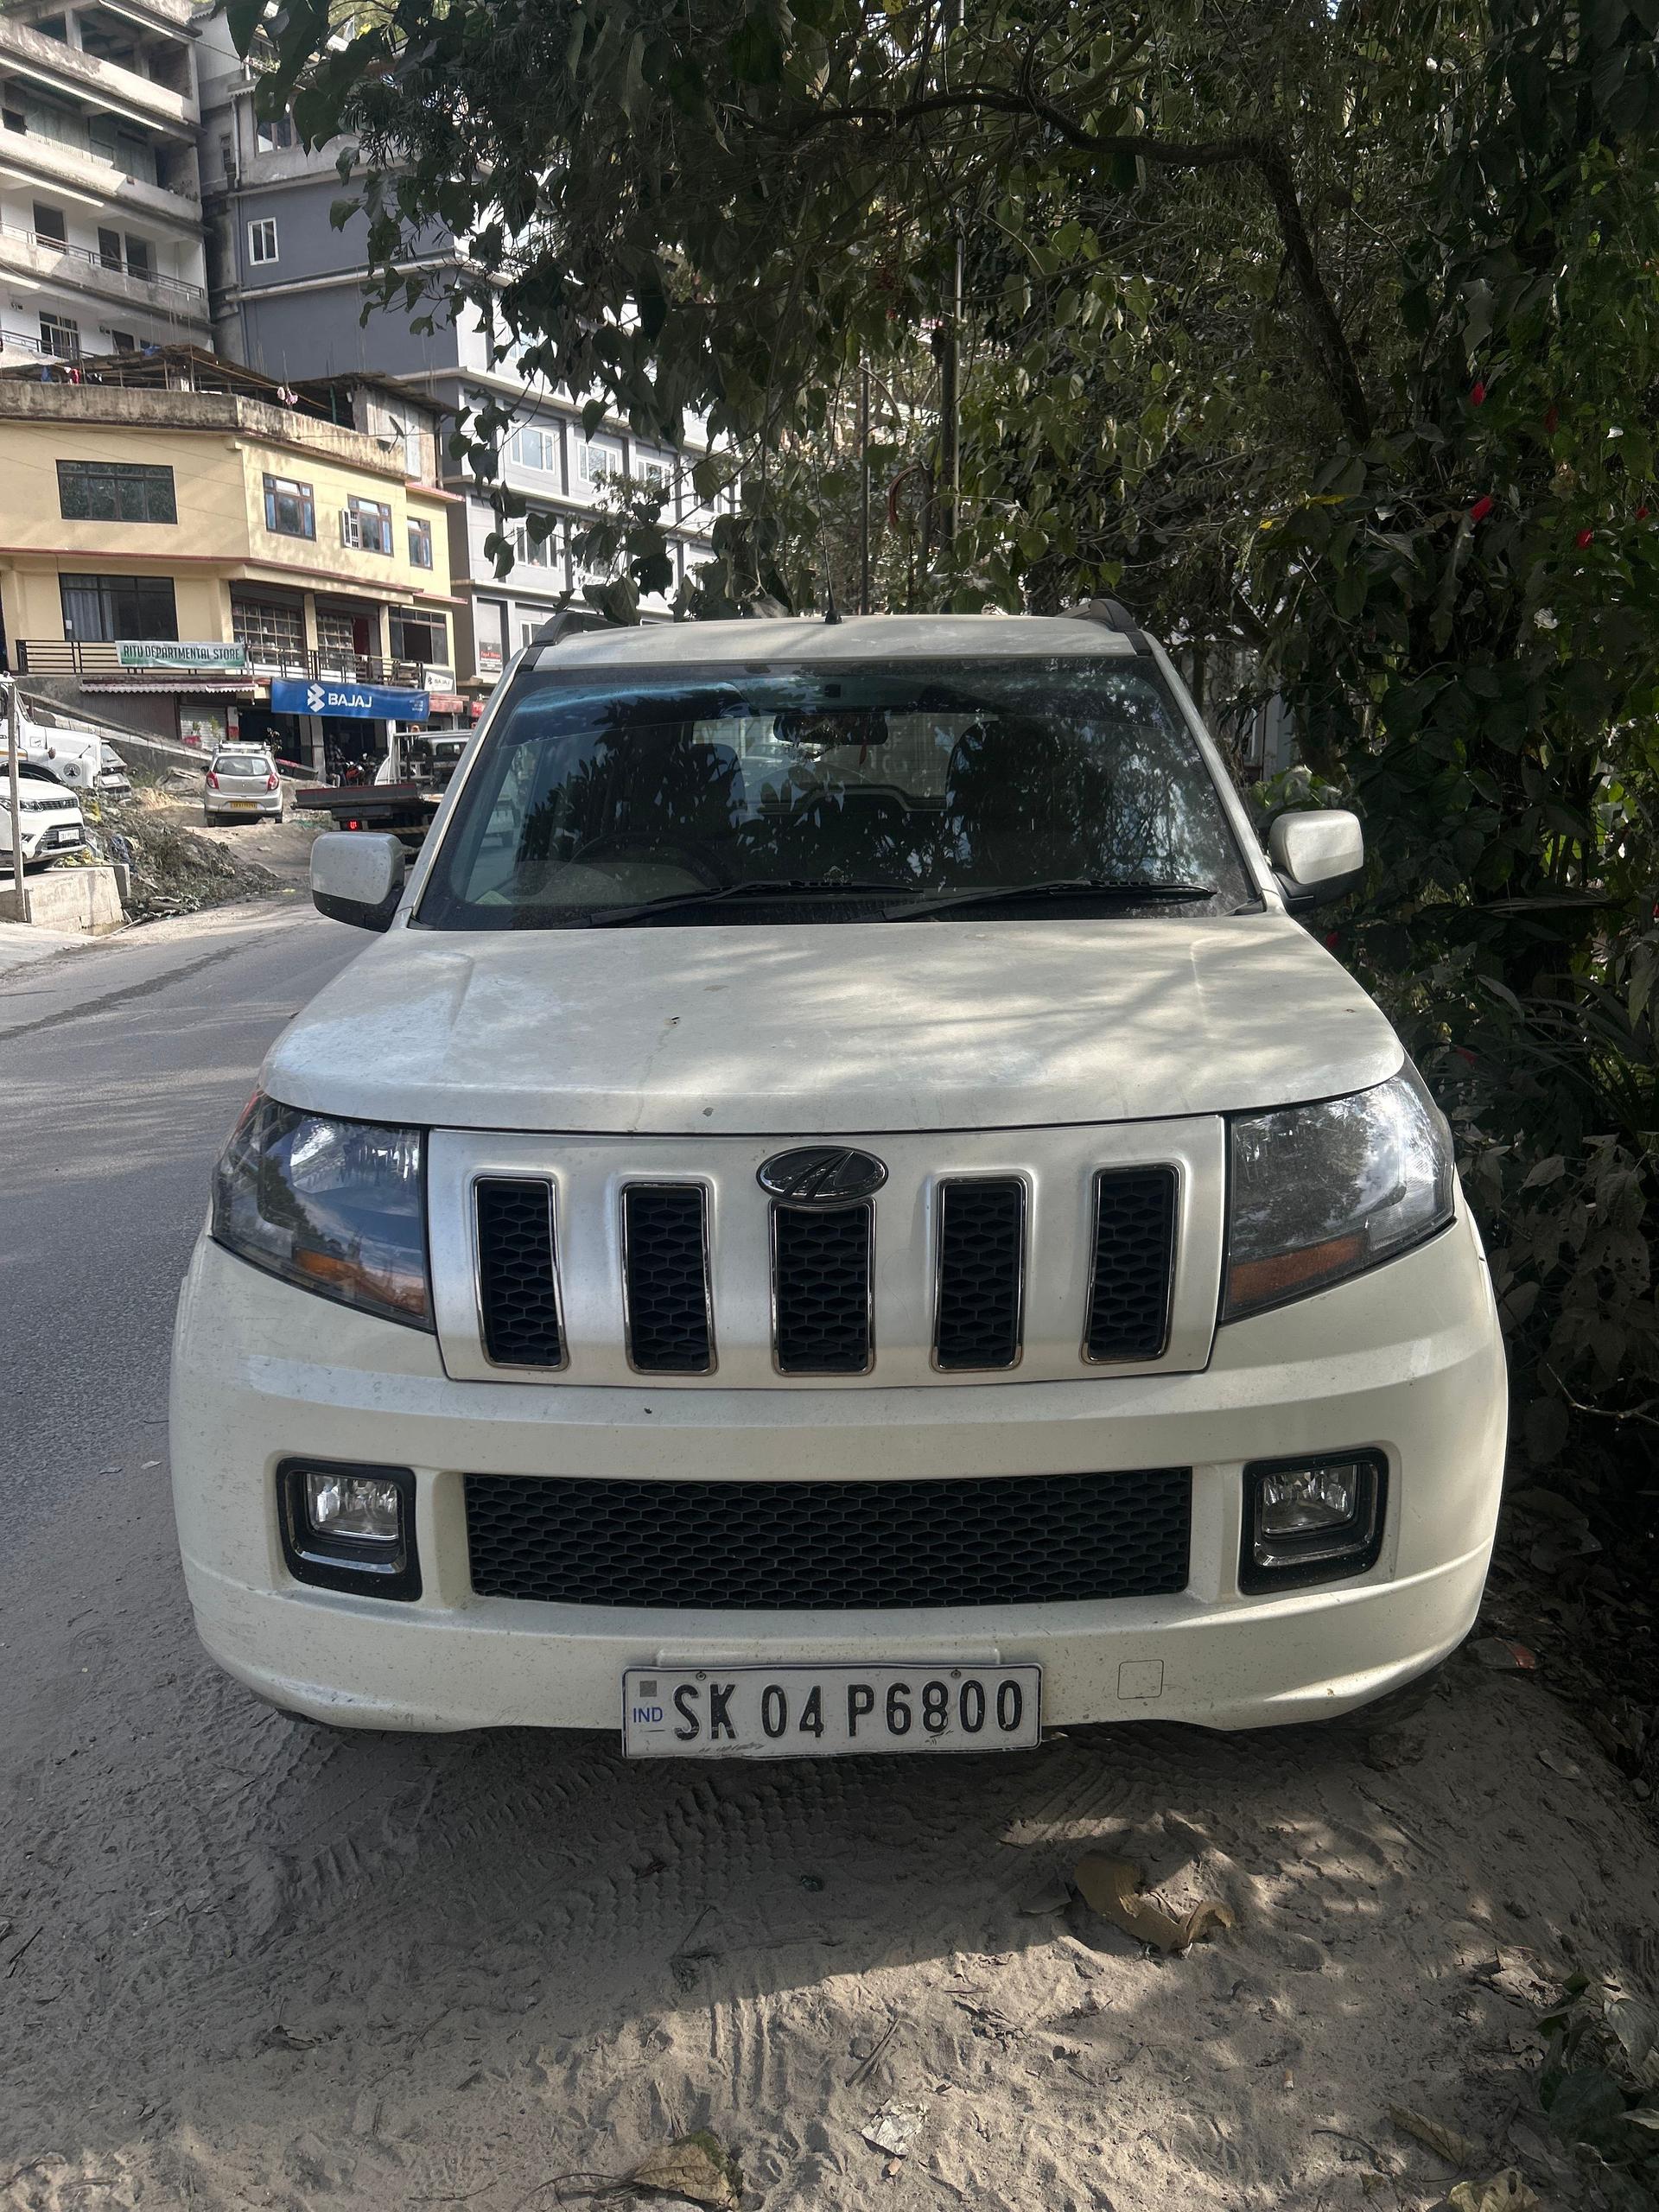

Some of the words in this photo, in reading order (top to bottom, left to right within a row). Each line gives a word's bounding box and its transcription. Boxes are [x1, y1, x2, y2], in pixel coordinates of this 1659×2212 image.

[124, 645, 143, 658] RITU
[145, 645, 210, 660] DEPARTMENTAL
[213, 648, 239, 660] STORE
[327, 692, 372, 709] BAJAJ
[632, 1707, 664, 1723] IND
[673, 1684, 736, 1741] SK
[761, 1684, 824, 1738] 04
[848, 1680, 1023, 1737] P6800
